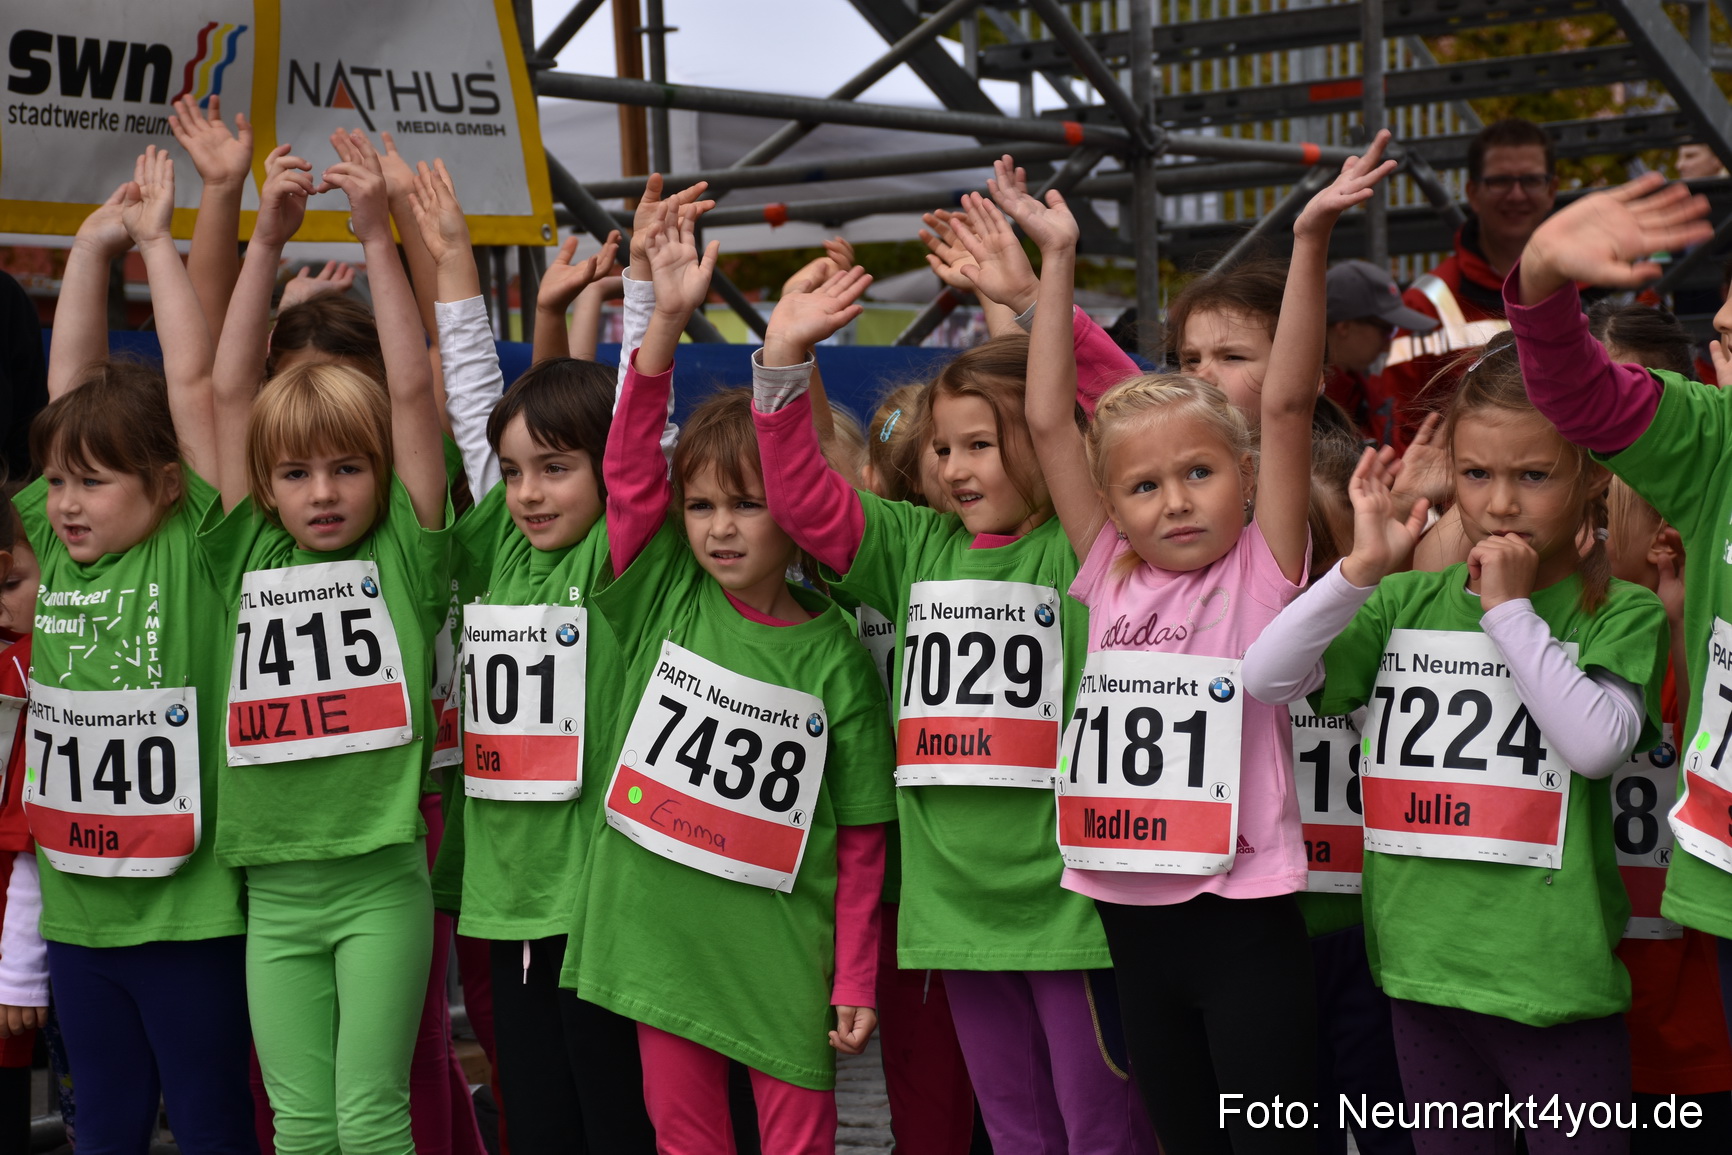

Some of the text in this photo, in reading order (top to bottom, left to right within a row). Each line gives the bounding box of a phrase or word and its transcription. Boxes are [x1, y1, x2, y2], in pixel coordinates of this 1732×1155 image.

[8, 29, 173, 105] swn
[288, 58, 501, 132] NATHUS
[8, 102, 119, 132] stadtwerke
[396, 120, 506, 136] MEDIA GMBH
[260, 582, 354, 607] Neumarkt
[931, 602, 1026, 622] Neumarkt
[465, 625, 547, 643] Neumarkt
[1100, 612, 1188, 650] adidas
[236, 607, 382, 691] 7415
[385, 668, 394, 680] K
[903, 631, 1044, 708] 7029
[656, 660, 800, 730] PARTL Neumarkt
[1098, 673, 1199, 697] Neumarkt
[28, 698, 157, 727] PARTL Neumarkt
[238, 693, 350, 742] LUZIE
[1043, 704, 1052, 717] K
[565, 721, 572, 732] K
[915, 727, 992, 756] Anouk
[1375, 685, 1547, 776] 7224
[475, 744, 500, 772] Eva
[645, 694, 807, 812] 7438
[1069, 705, 1207, 788] 7181
[33, 728, 177, 805] 7140
[1546, 773, 1555, 787] K
[178, 799, 187, 810] K
[1215, 785, 1224, 798] K
[793, 811, 802, 824] K
[1404, 791, 1471, 827] Julia
[69, 822, 119, 855] Anja
[650, 799, 726, 852] Emma
[1083, 808, 1168, 842] Madlen
